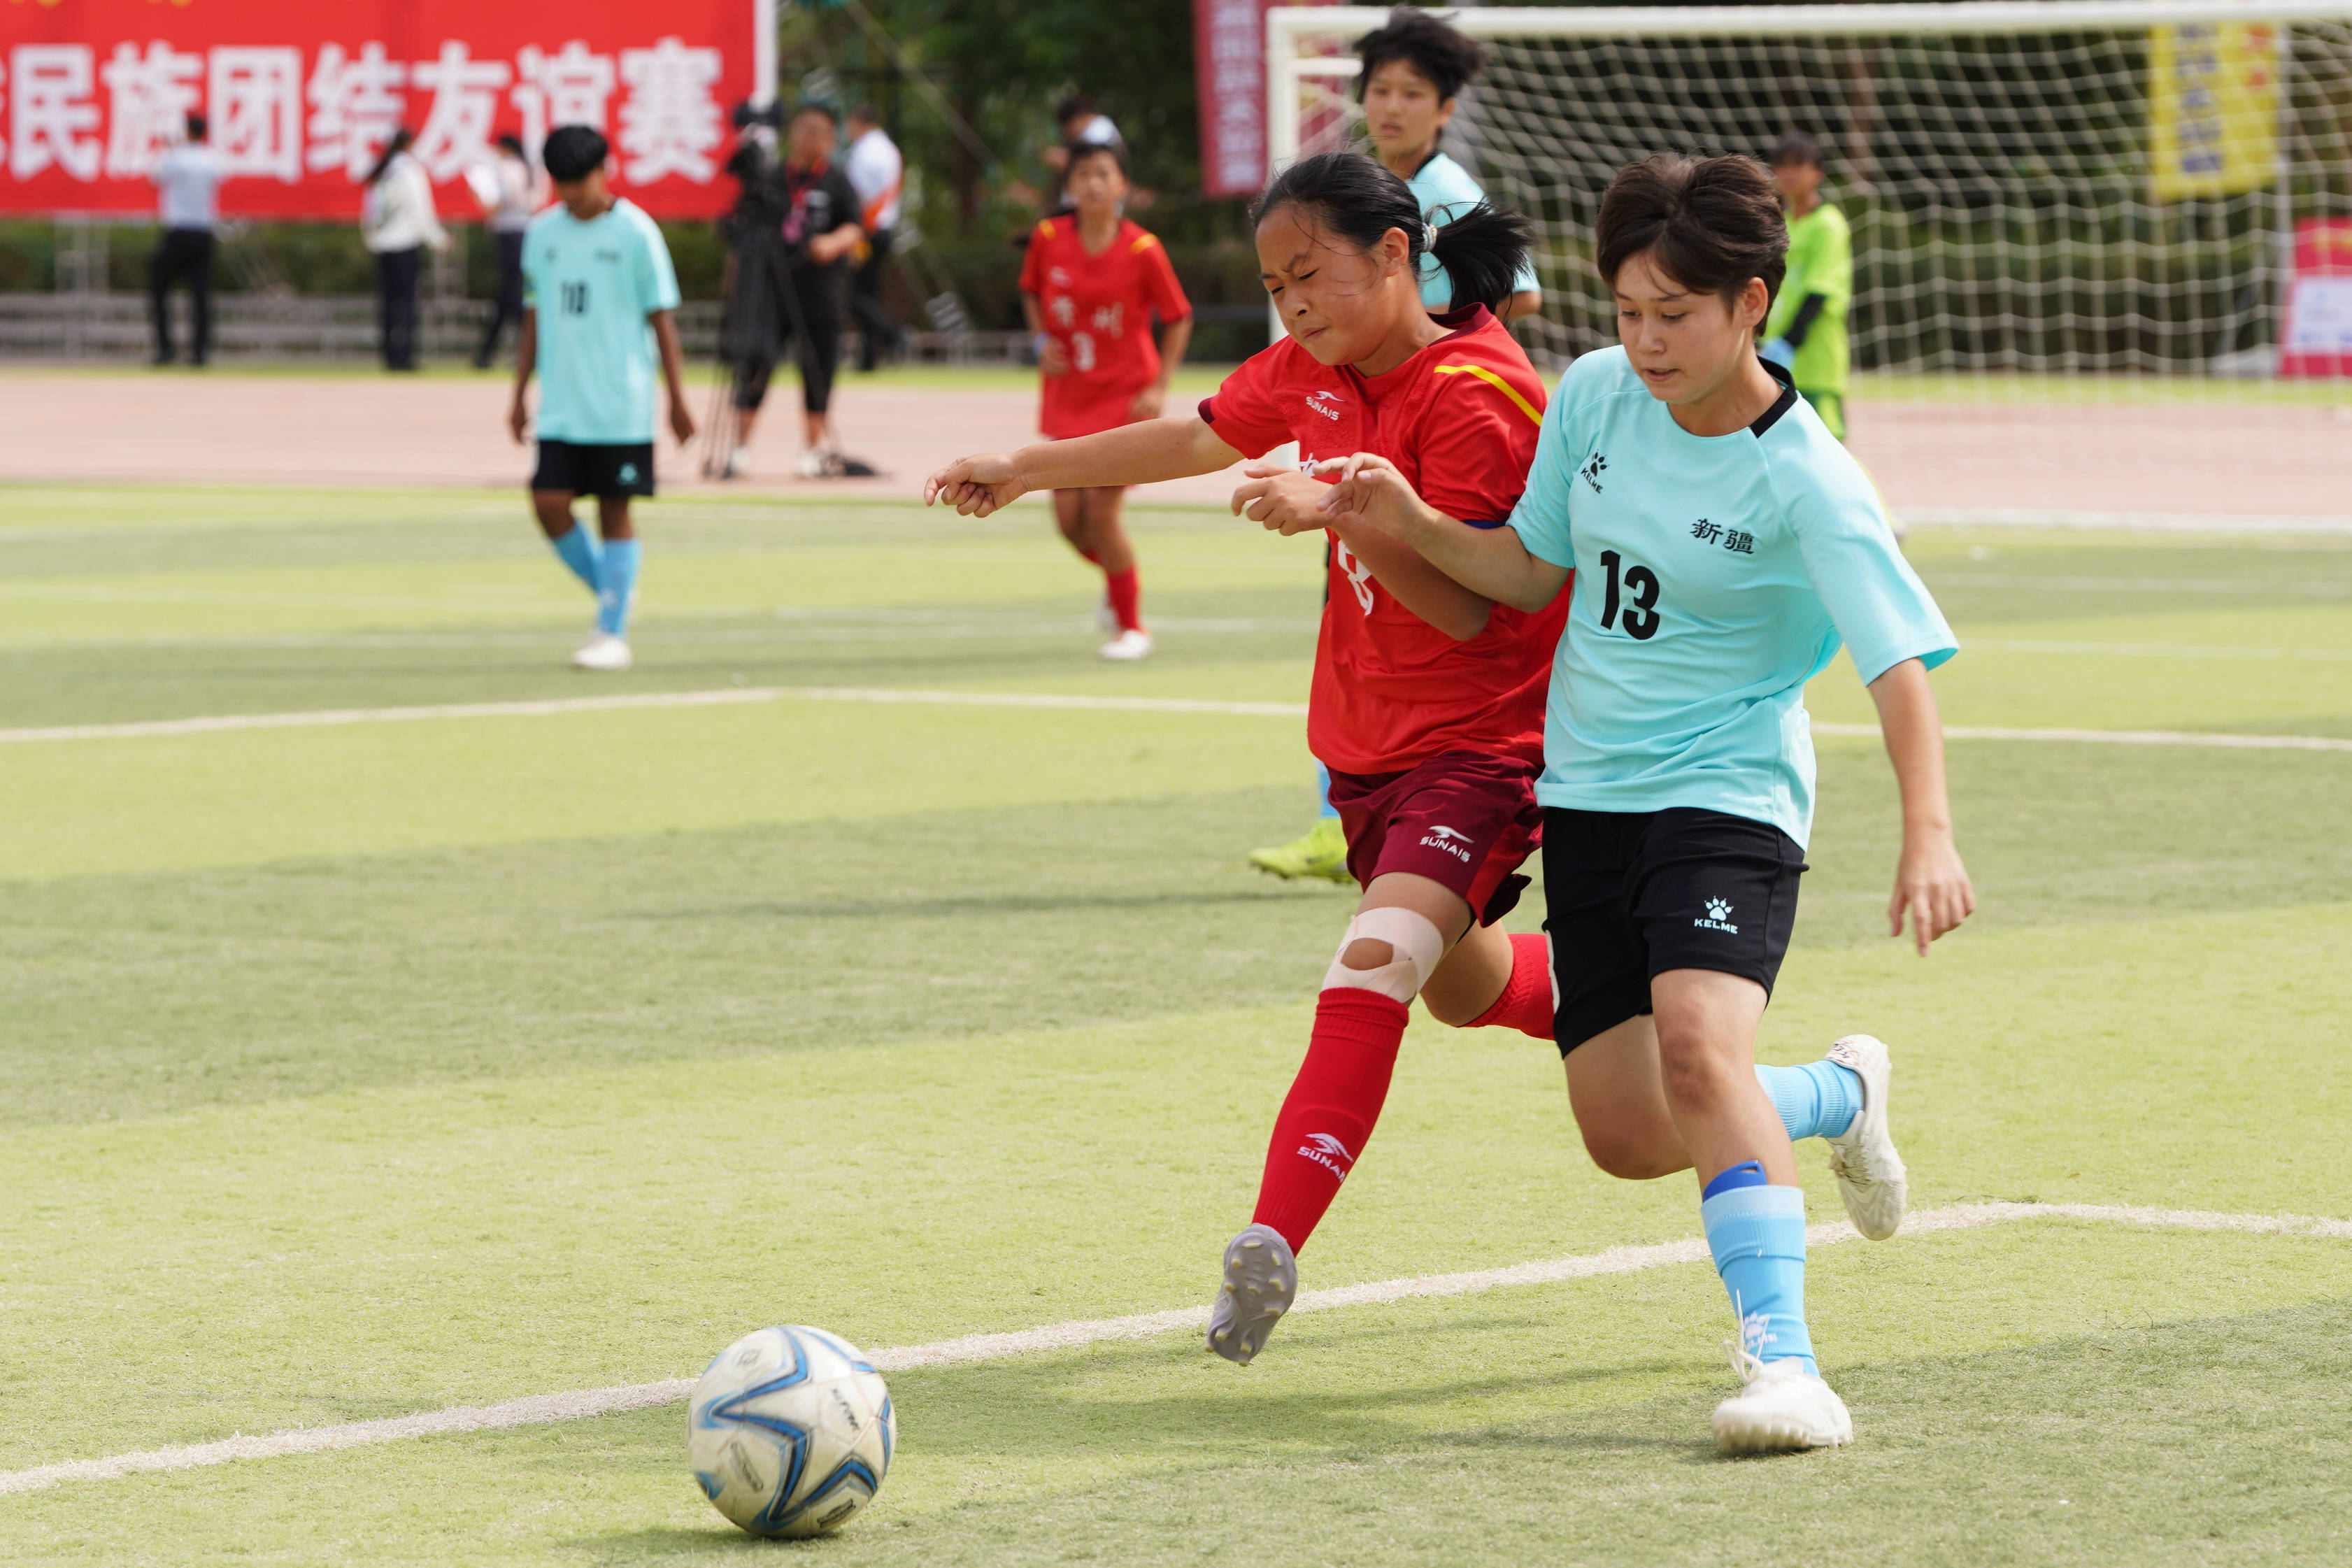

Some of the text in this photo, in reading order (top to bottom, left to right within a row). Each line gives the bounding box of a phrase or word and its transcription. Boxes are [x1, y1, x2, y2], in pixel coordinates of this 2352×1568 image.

[0, 36, 724, 187] 民族团结友谊赛
[1306, 396, 1340, 421] SUNAIS
[1581, 467, 1603, 494] KELME
[1690, 518, 1755, 554] 新疆
[1600, 550, 1660, 640] 13
[1419, 836, 1471, 863] SUNAIS
[1694, 918, 1738, 934] KELME
